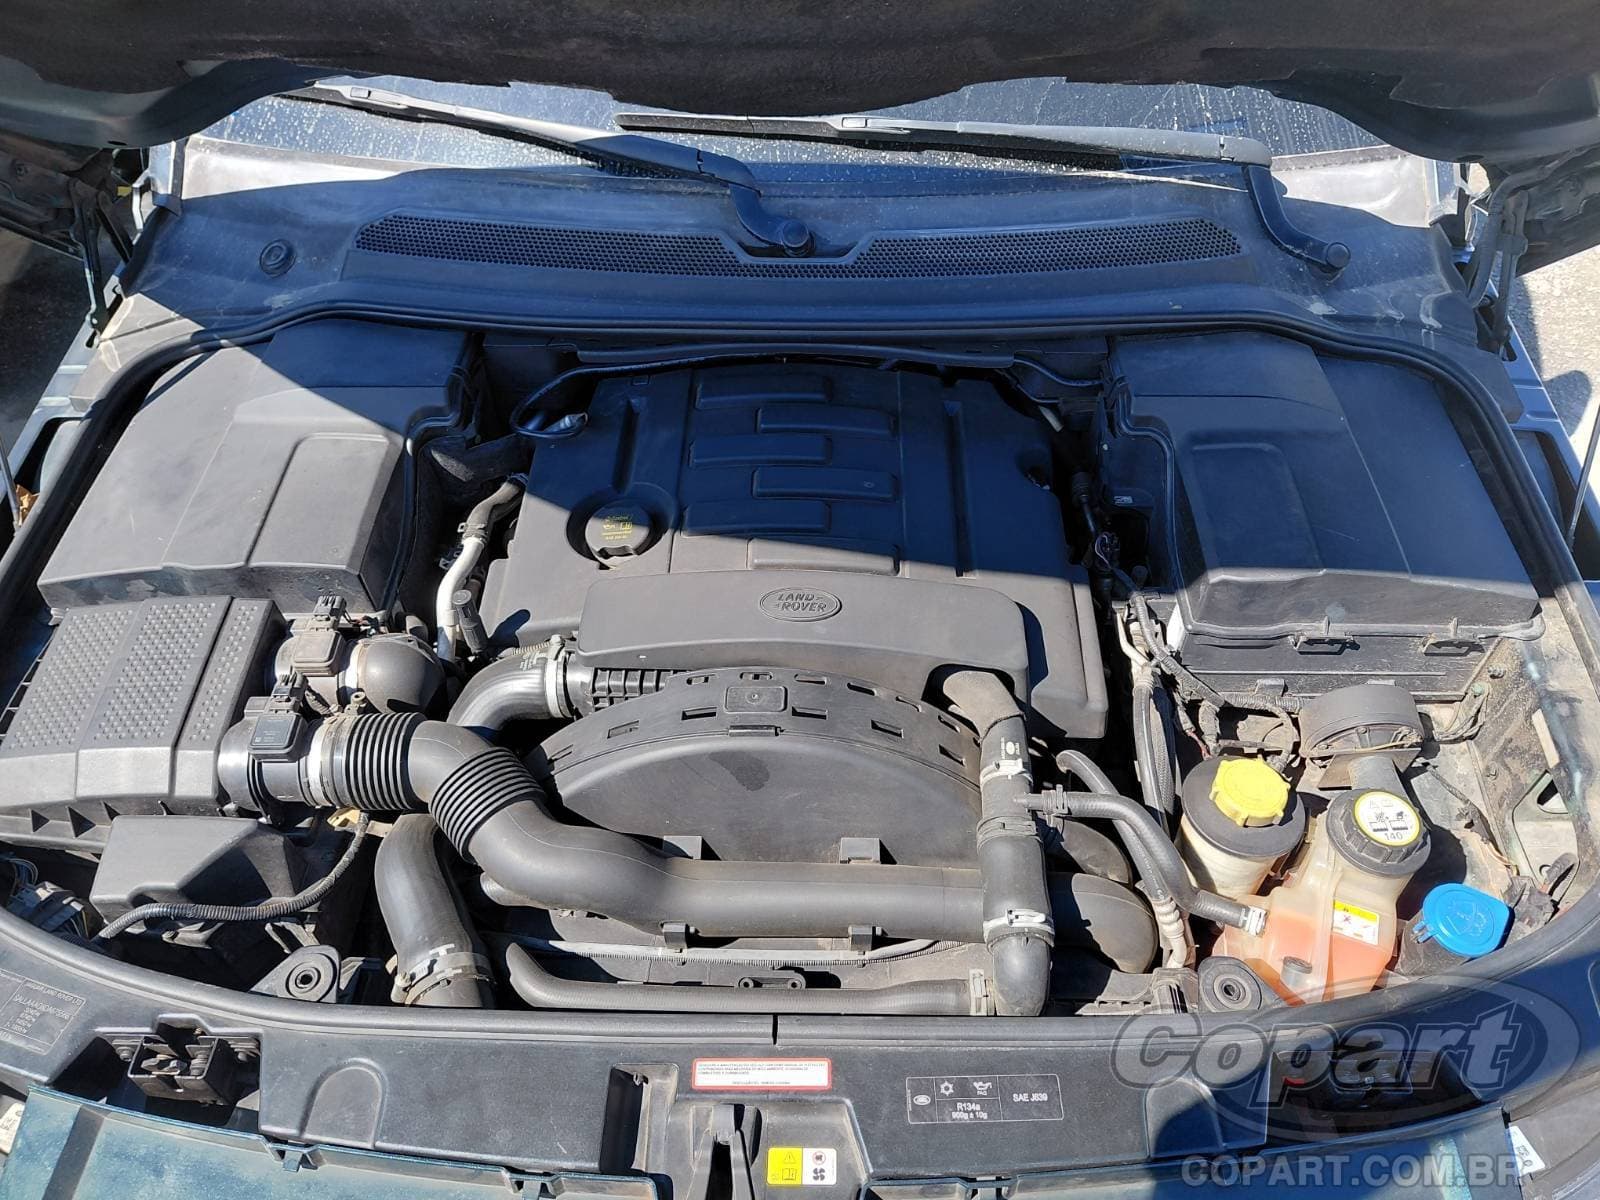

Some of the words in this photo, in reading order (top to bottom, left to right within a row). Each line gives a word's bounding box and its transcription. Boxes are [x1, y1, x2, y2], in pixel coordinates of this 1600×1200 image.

[778, 593, 815, 602] LAND
[780, 601, 827, 612] ROVER
[1012, 1092, 1029, 1102] SAE
